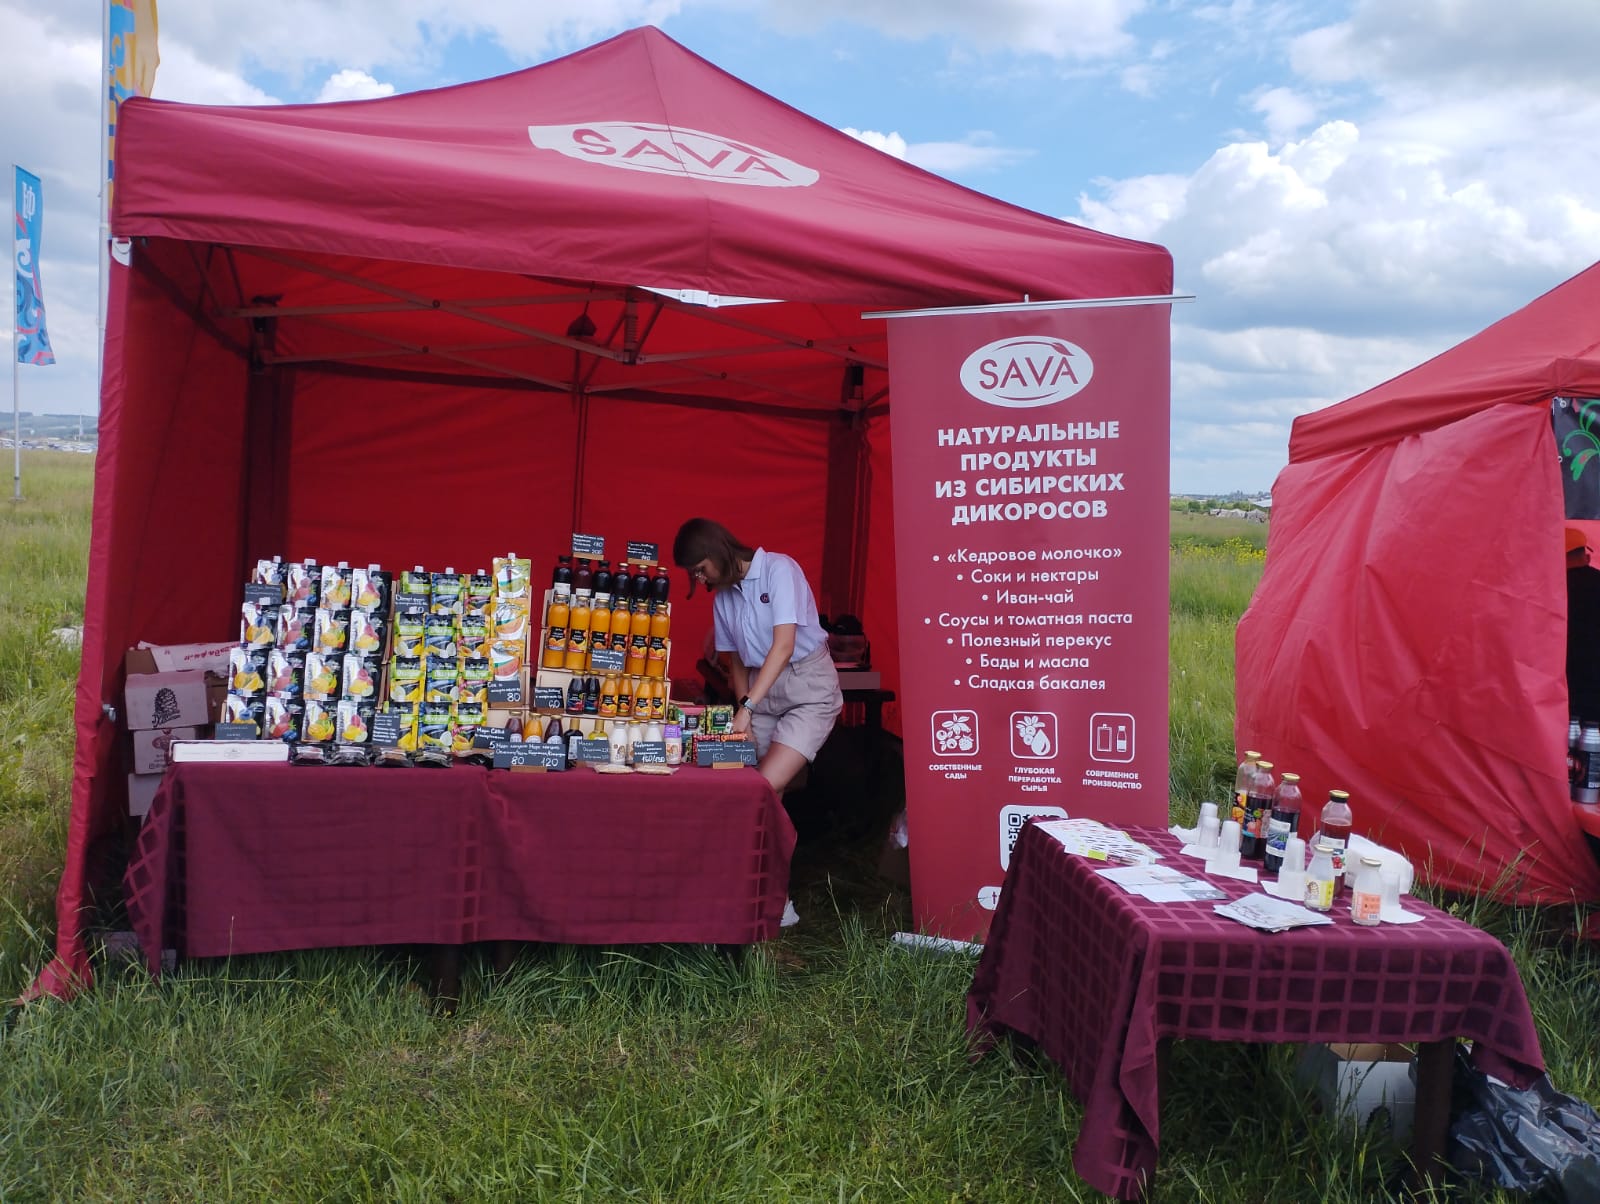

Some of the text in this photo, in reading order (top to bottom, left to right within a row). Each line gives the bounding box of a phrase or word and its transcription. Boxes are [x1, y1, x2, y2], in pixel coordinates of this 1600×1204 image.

[572, 129, 792, 181] SAVA
[979, 356, 1079, 390] SAVA
[938, 421, 1119, 446] НАТУРАЛЬНЫЕ
[961, 448, 1096, 471] ПРОДУКТЫ
[936, 473, 1125, 498] ИЗ СИБИРСКИХ
[952, 500, 1107, 525] ДИКОРОСОВ
[948, 548, 1122, 565] «Кедровое молочко»
[971, 569, 1098, 584] Соки и нектары
[997, 589, 1073, 604] Иван-чай
[939, 613, 1132, 629] Соусы и томатная паста
[962, 633, 1111, 649] Полезный перекус
[981, 654, 1089, 669] Бады и масла
[969, 675, 1105, 691] Сладкая бакалея
[507, 693, 520, 702] 80
[511, 756, 525, 765] 80
[541, 757, 559, 767] 120
[1086, 770, 1138, 779] СОВРЕМЕННОЕ
[1083, 779, 1142, 789] ПРОИЗВОДСТВО
